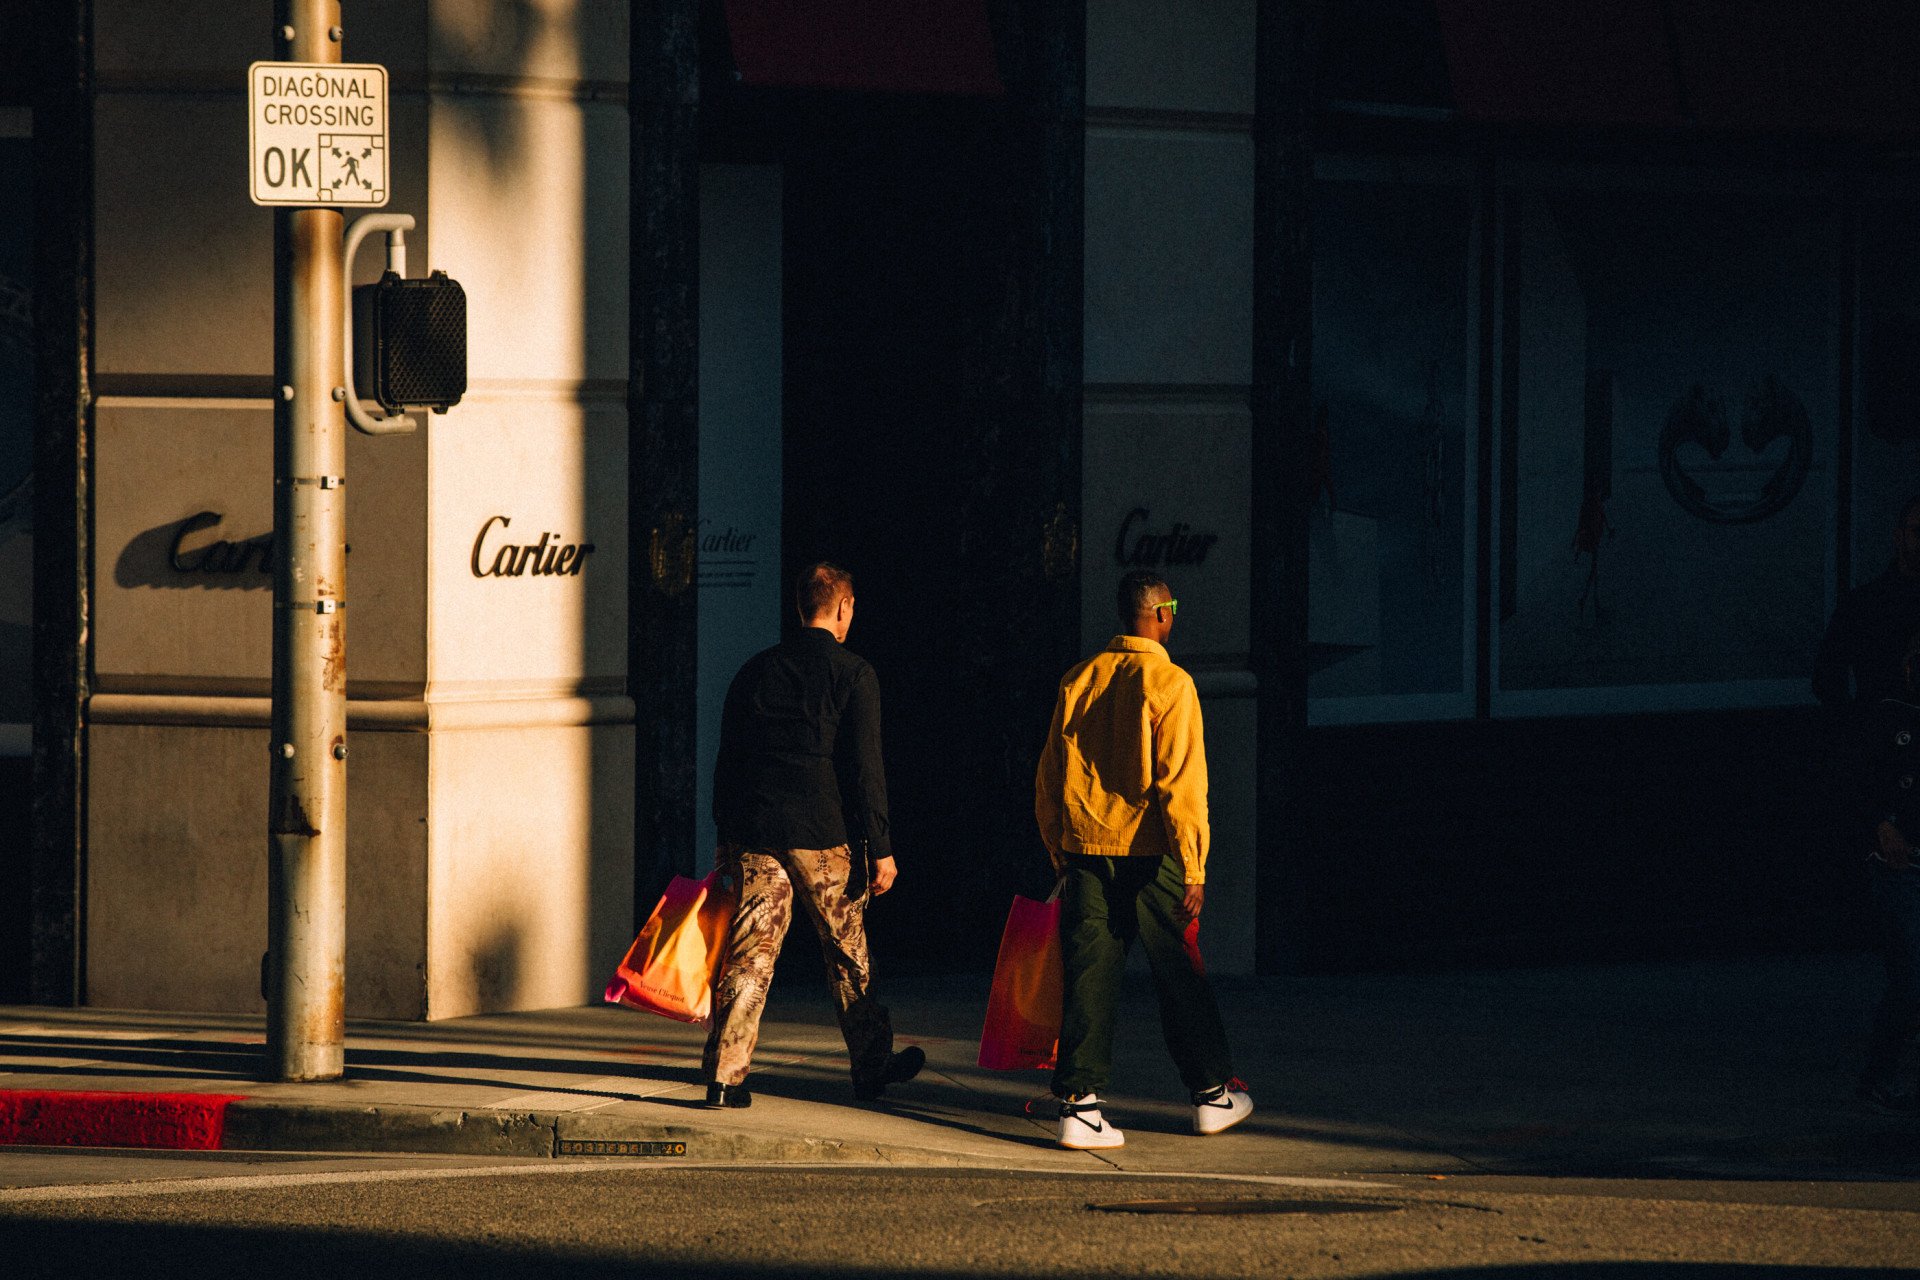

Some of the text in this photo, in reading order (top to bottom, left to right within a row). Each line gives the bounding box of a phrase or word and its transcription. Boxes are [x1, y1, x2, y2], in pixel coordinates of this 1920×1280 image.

[263, 76, 375, 99] DIAGONAL
[264, 103, 374, 126] CROSSING
[264, 146, 312, 188] OK
[169, 510, 274, 573] Cart
[471, 515, 596, 578] Cartier
[1115, 507, 1218, 568] Cartier
